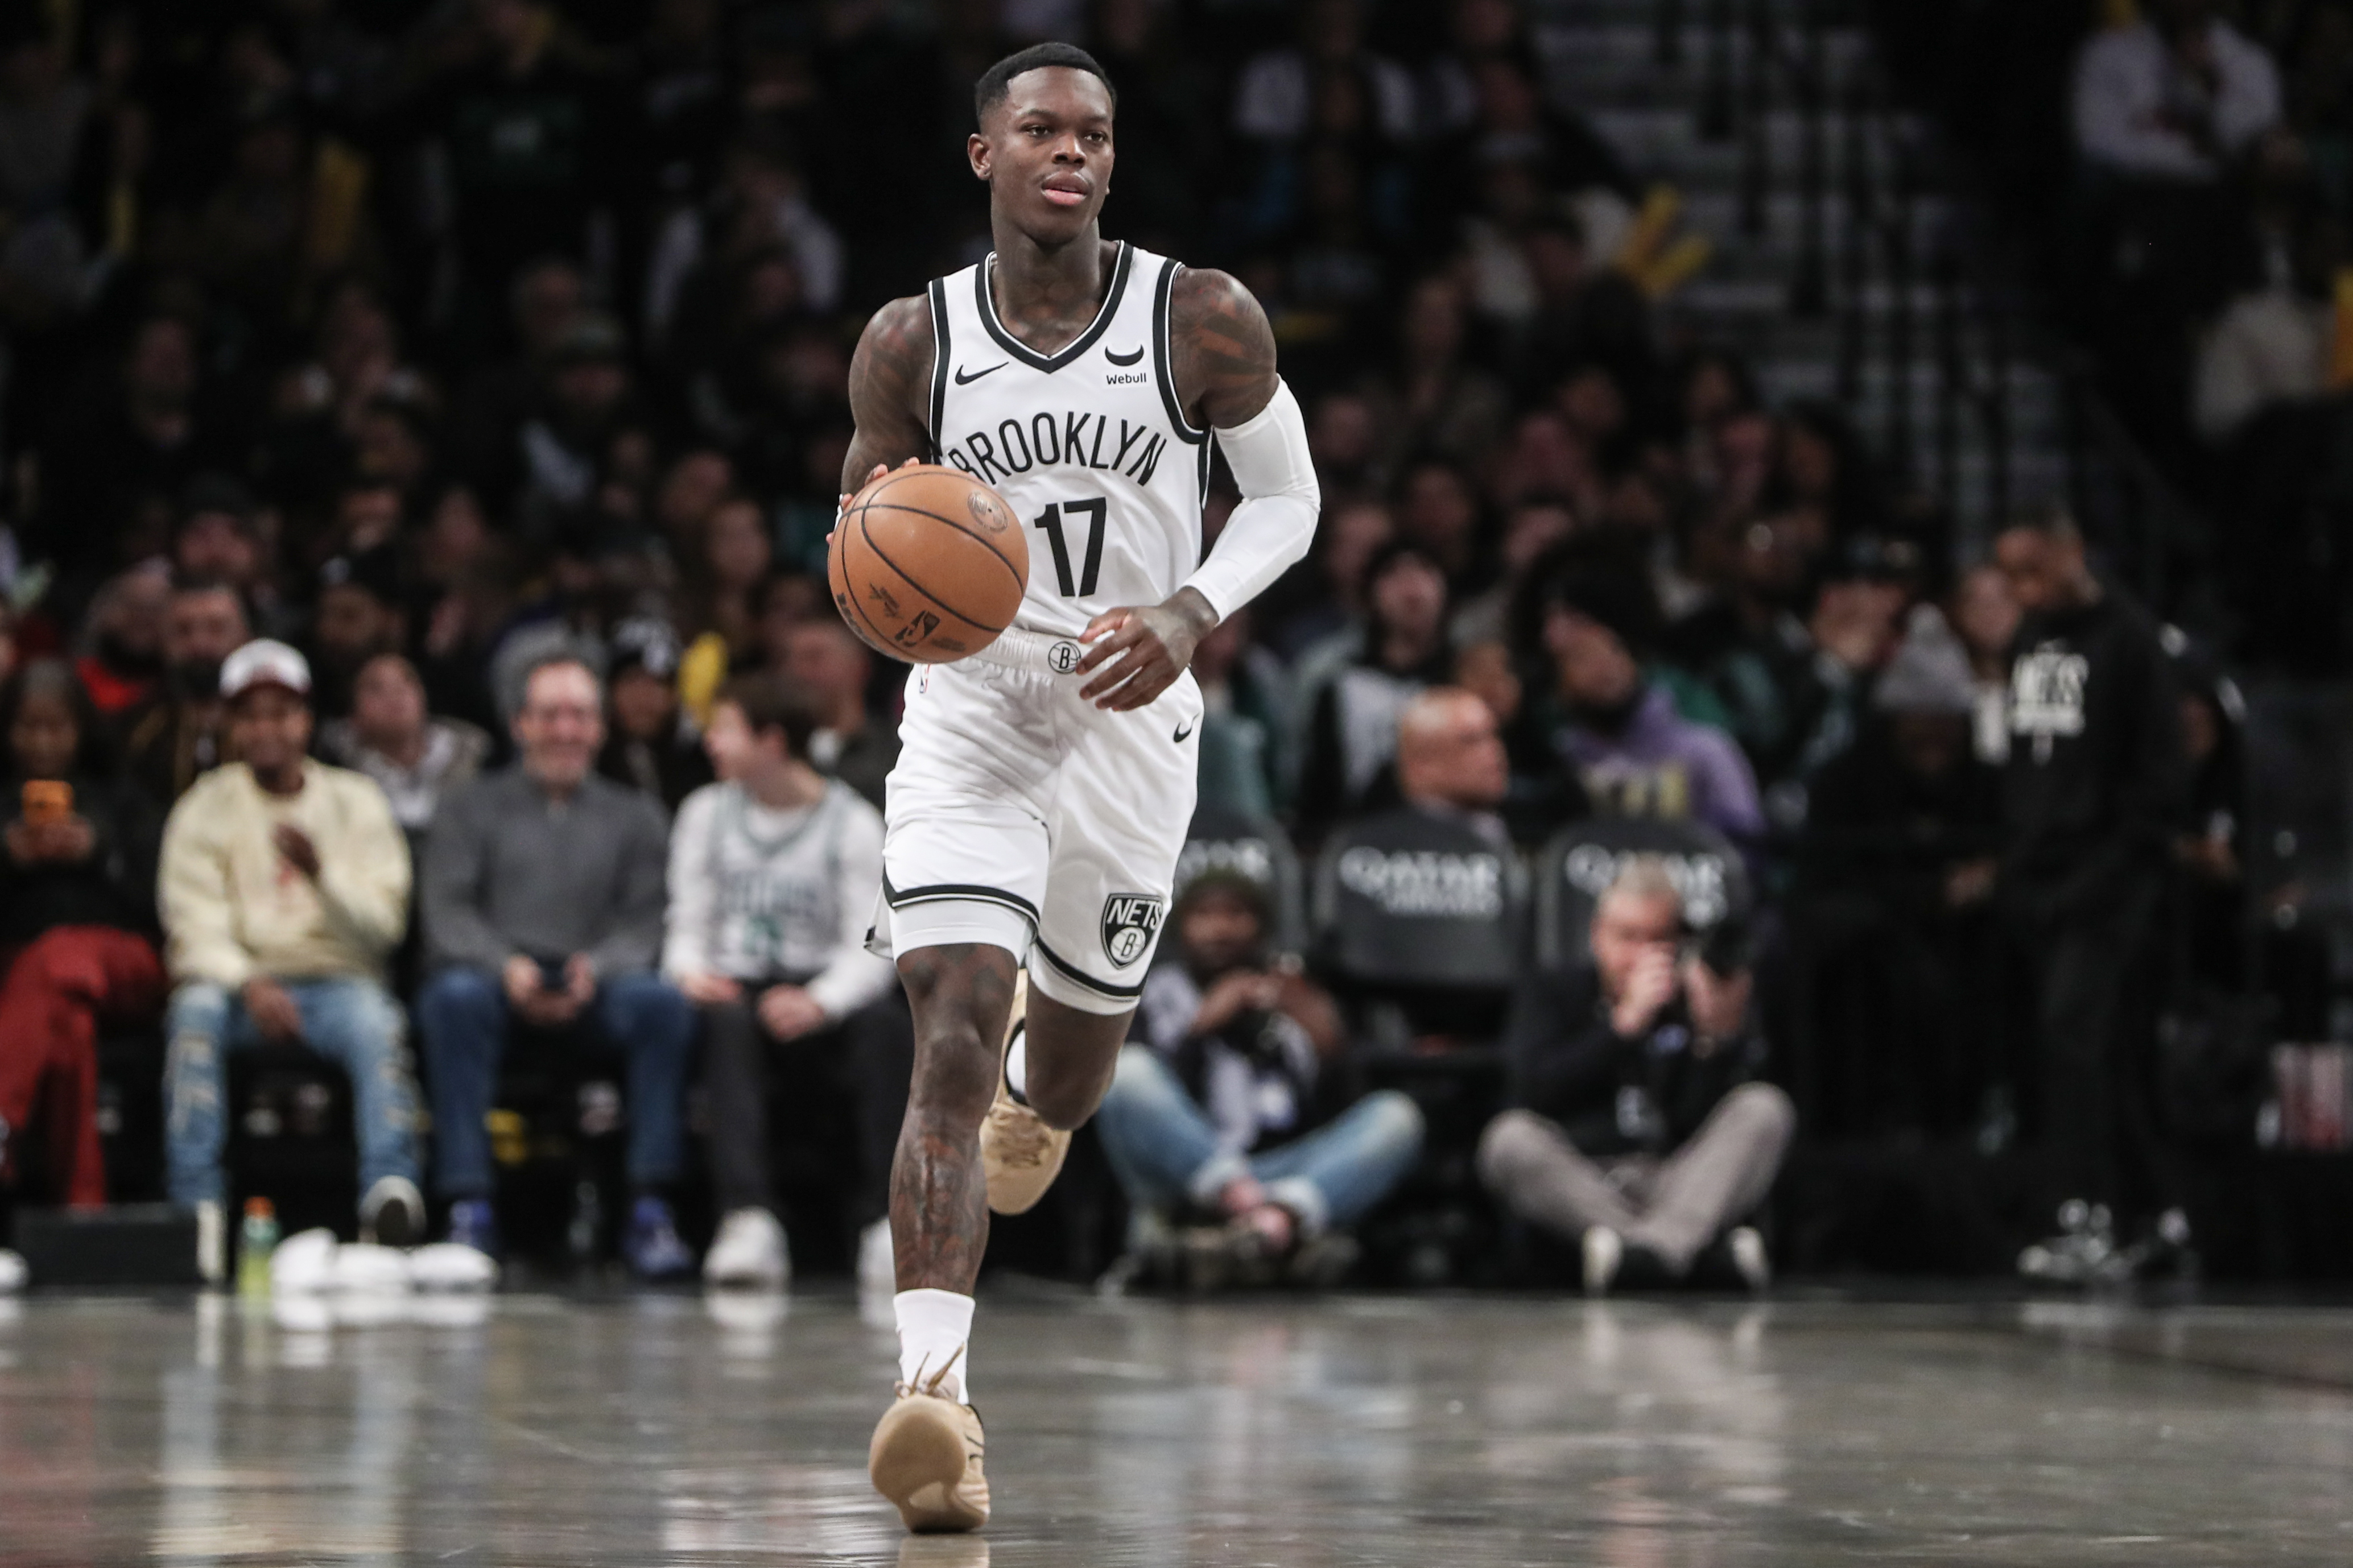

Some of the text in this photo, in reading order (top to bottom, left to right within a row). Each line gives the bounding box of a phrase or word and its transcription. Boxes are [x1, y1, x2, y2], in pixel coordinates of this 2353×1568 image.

[1106, 373, 1146, 384] Webull
[948, 411, 1167, 486] BROOKLYN
[1034, 497, 1107, 597] 17
[1059, 646, 1071, 669] B
[1107, 899, 1163, 930] NETS
[1121, 933, 1137, 956] B
